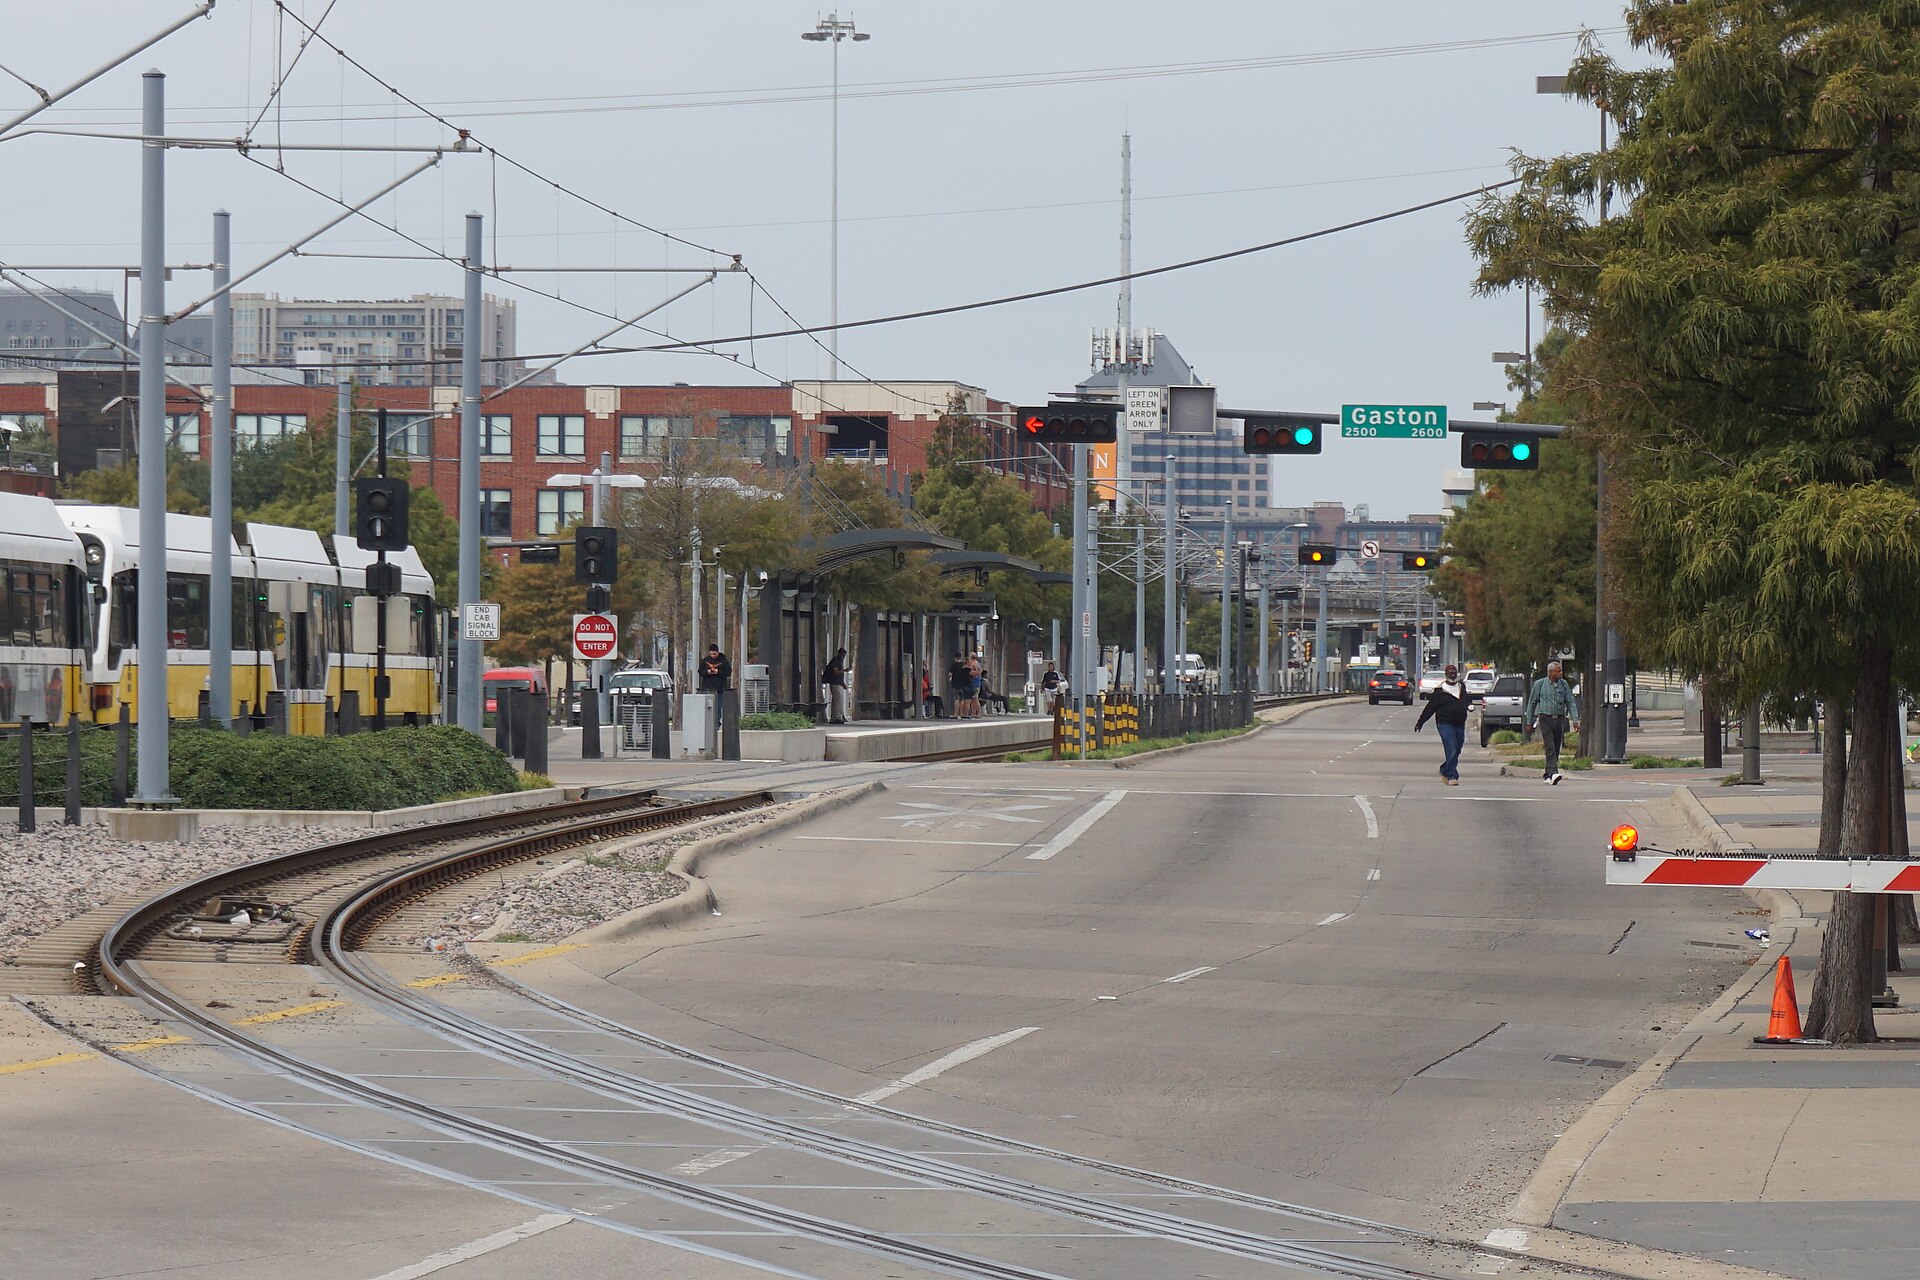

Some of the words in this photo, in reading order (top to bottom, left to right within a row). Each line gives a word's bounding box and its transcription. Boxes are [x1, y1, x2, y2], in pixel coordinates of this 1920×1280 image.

[1351, 407, 1437, 425] Gaston
[1132, 420, 1154, 428] ONLY
[1345, 427, 1377, 437] 2500
[1411, 428, 1443, 437] 2600
[1095, 452, 1109, 470] N
[474, 606, 490, 614] END
[580, 623, 591, 631] DO
[595, 623, 611, 631] NOT
[583, 642, 608, 650] ENTER
